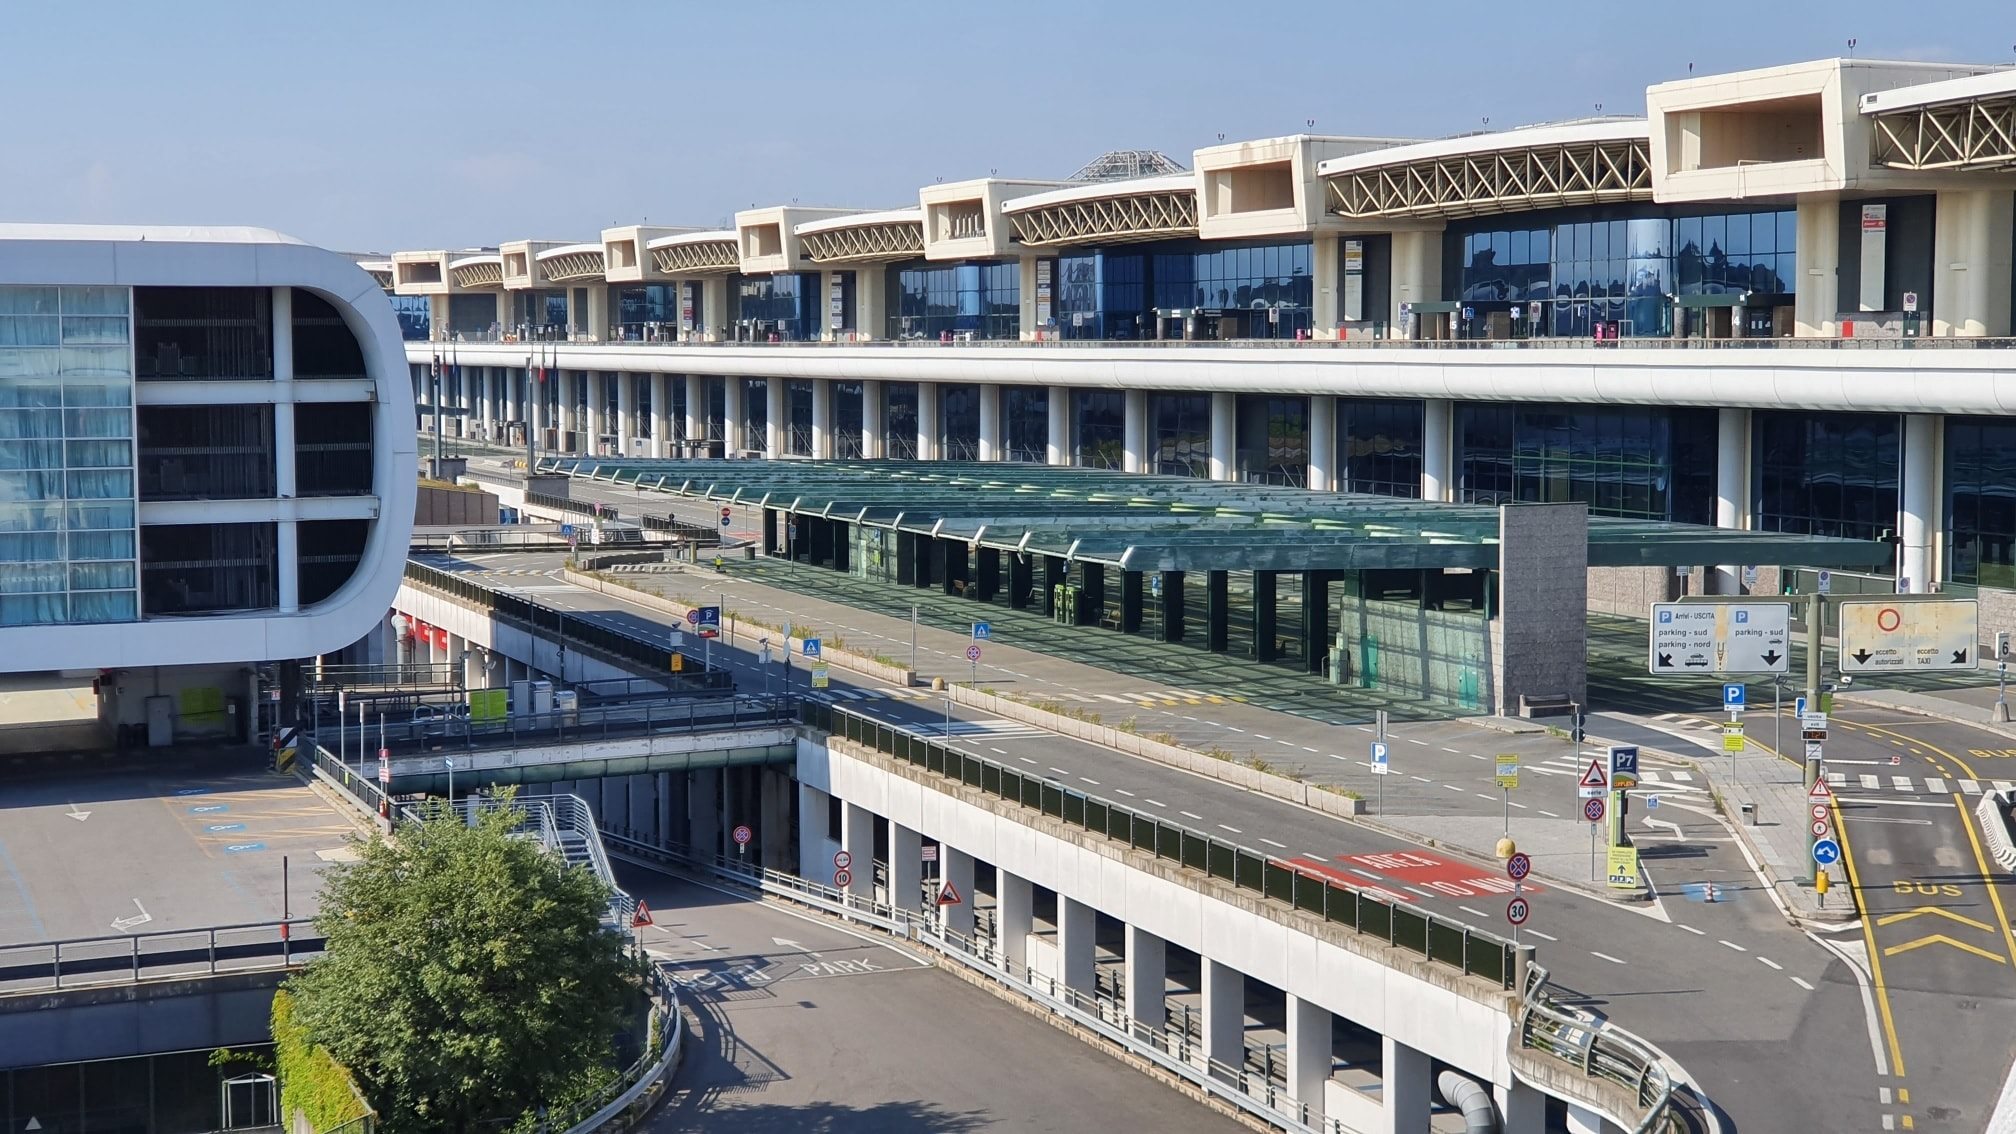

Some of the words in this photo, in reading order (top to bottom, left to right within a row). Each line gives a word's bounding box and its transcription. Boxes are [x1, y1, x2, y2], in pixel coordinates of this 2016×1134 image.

[1450, 320, 1458, 330] 5
[1694, 612, 1715, 620] USCITA
[1658, 629, 1687, 637] parking
[1735, 629, 1763, 637] parking
[1658, 641, 1687, 649] parking
[2002, 641, 2009, 655] 6
[1727, 687, 1740, 702] P
[1375, 744, 1386, 762] P
[1616, 753, 1633, 767] P7
[1351, 853, 1441, 870] AREA
[839, 873, 847, 883] 10
[1420, 881, 1475, 897] 10
[1893, 880, 1963, 897] BUS
[1511, 904, 1525, 918] 30
[800, 958, 883, 976] PARK
